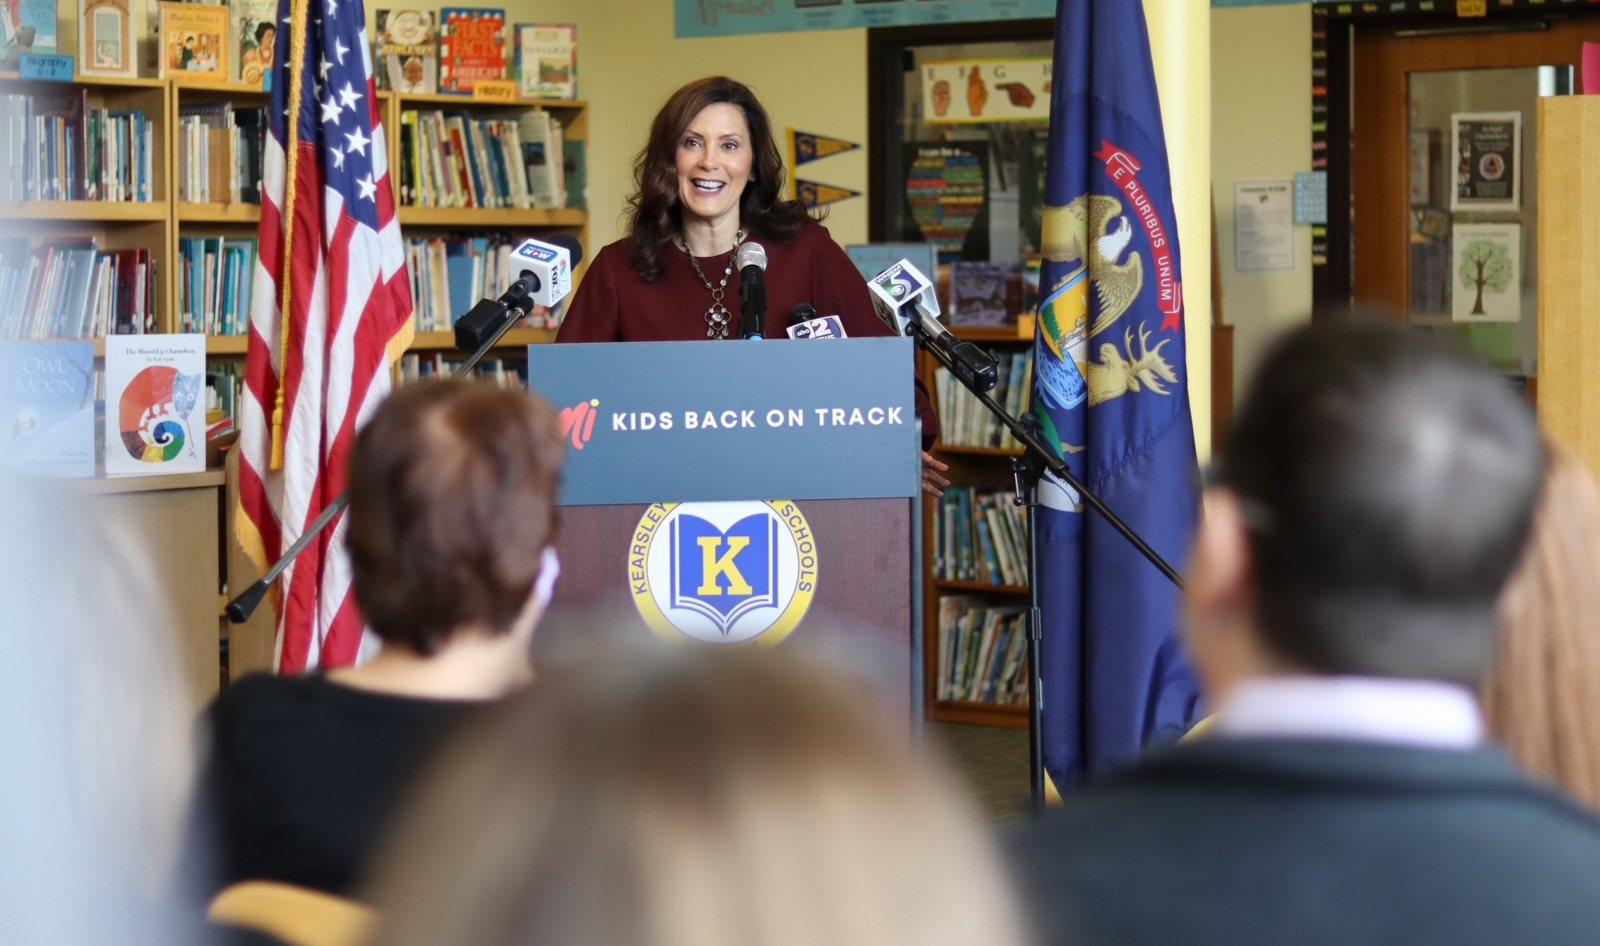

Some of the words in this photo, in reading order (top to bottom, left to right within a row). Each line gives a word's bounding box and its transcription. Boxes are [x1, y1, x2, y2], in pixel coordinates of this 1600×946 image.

[454, 20, 499, 39] FIRST
[452, 40, 499, 58] FACTS
[928, 67, 936, 80] E
[993, 64, 1006, 79] G
[478, 86, 511, 99] History
[1113, 167, 1125, 180] E
[1125, 180, 1165, 249] PLURIBUS
[1157, 255, 1172, 301] UNUM
[551, 264, 559, 289] FOX
[876, 263, 904, 284] WNEM
[890, 272, 912, 303] 5
[796, 328, 811, 337] abc
[23, 355, 67, 375] OWL
[16, 379, 75, 395] MOON
[612, 411, 674, 432] KIDS
[684, 409, 757, 430] BACK
[766, 408, 804, 428] ON
[814, 406, 903, 426] TRACK
[631, 501, 668, 595] KEARSLEY
[780, 503, 815, 593] SCHOOLS
[696, 535, 753, 596] K
